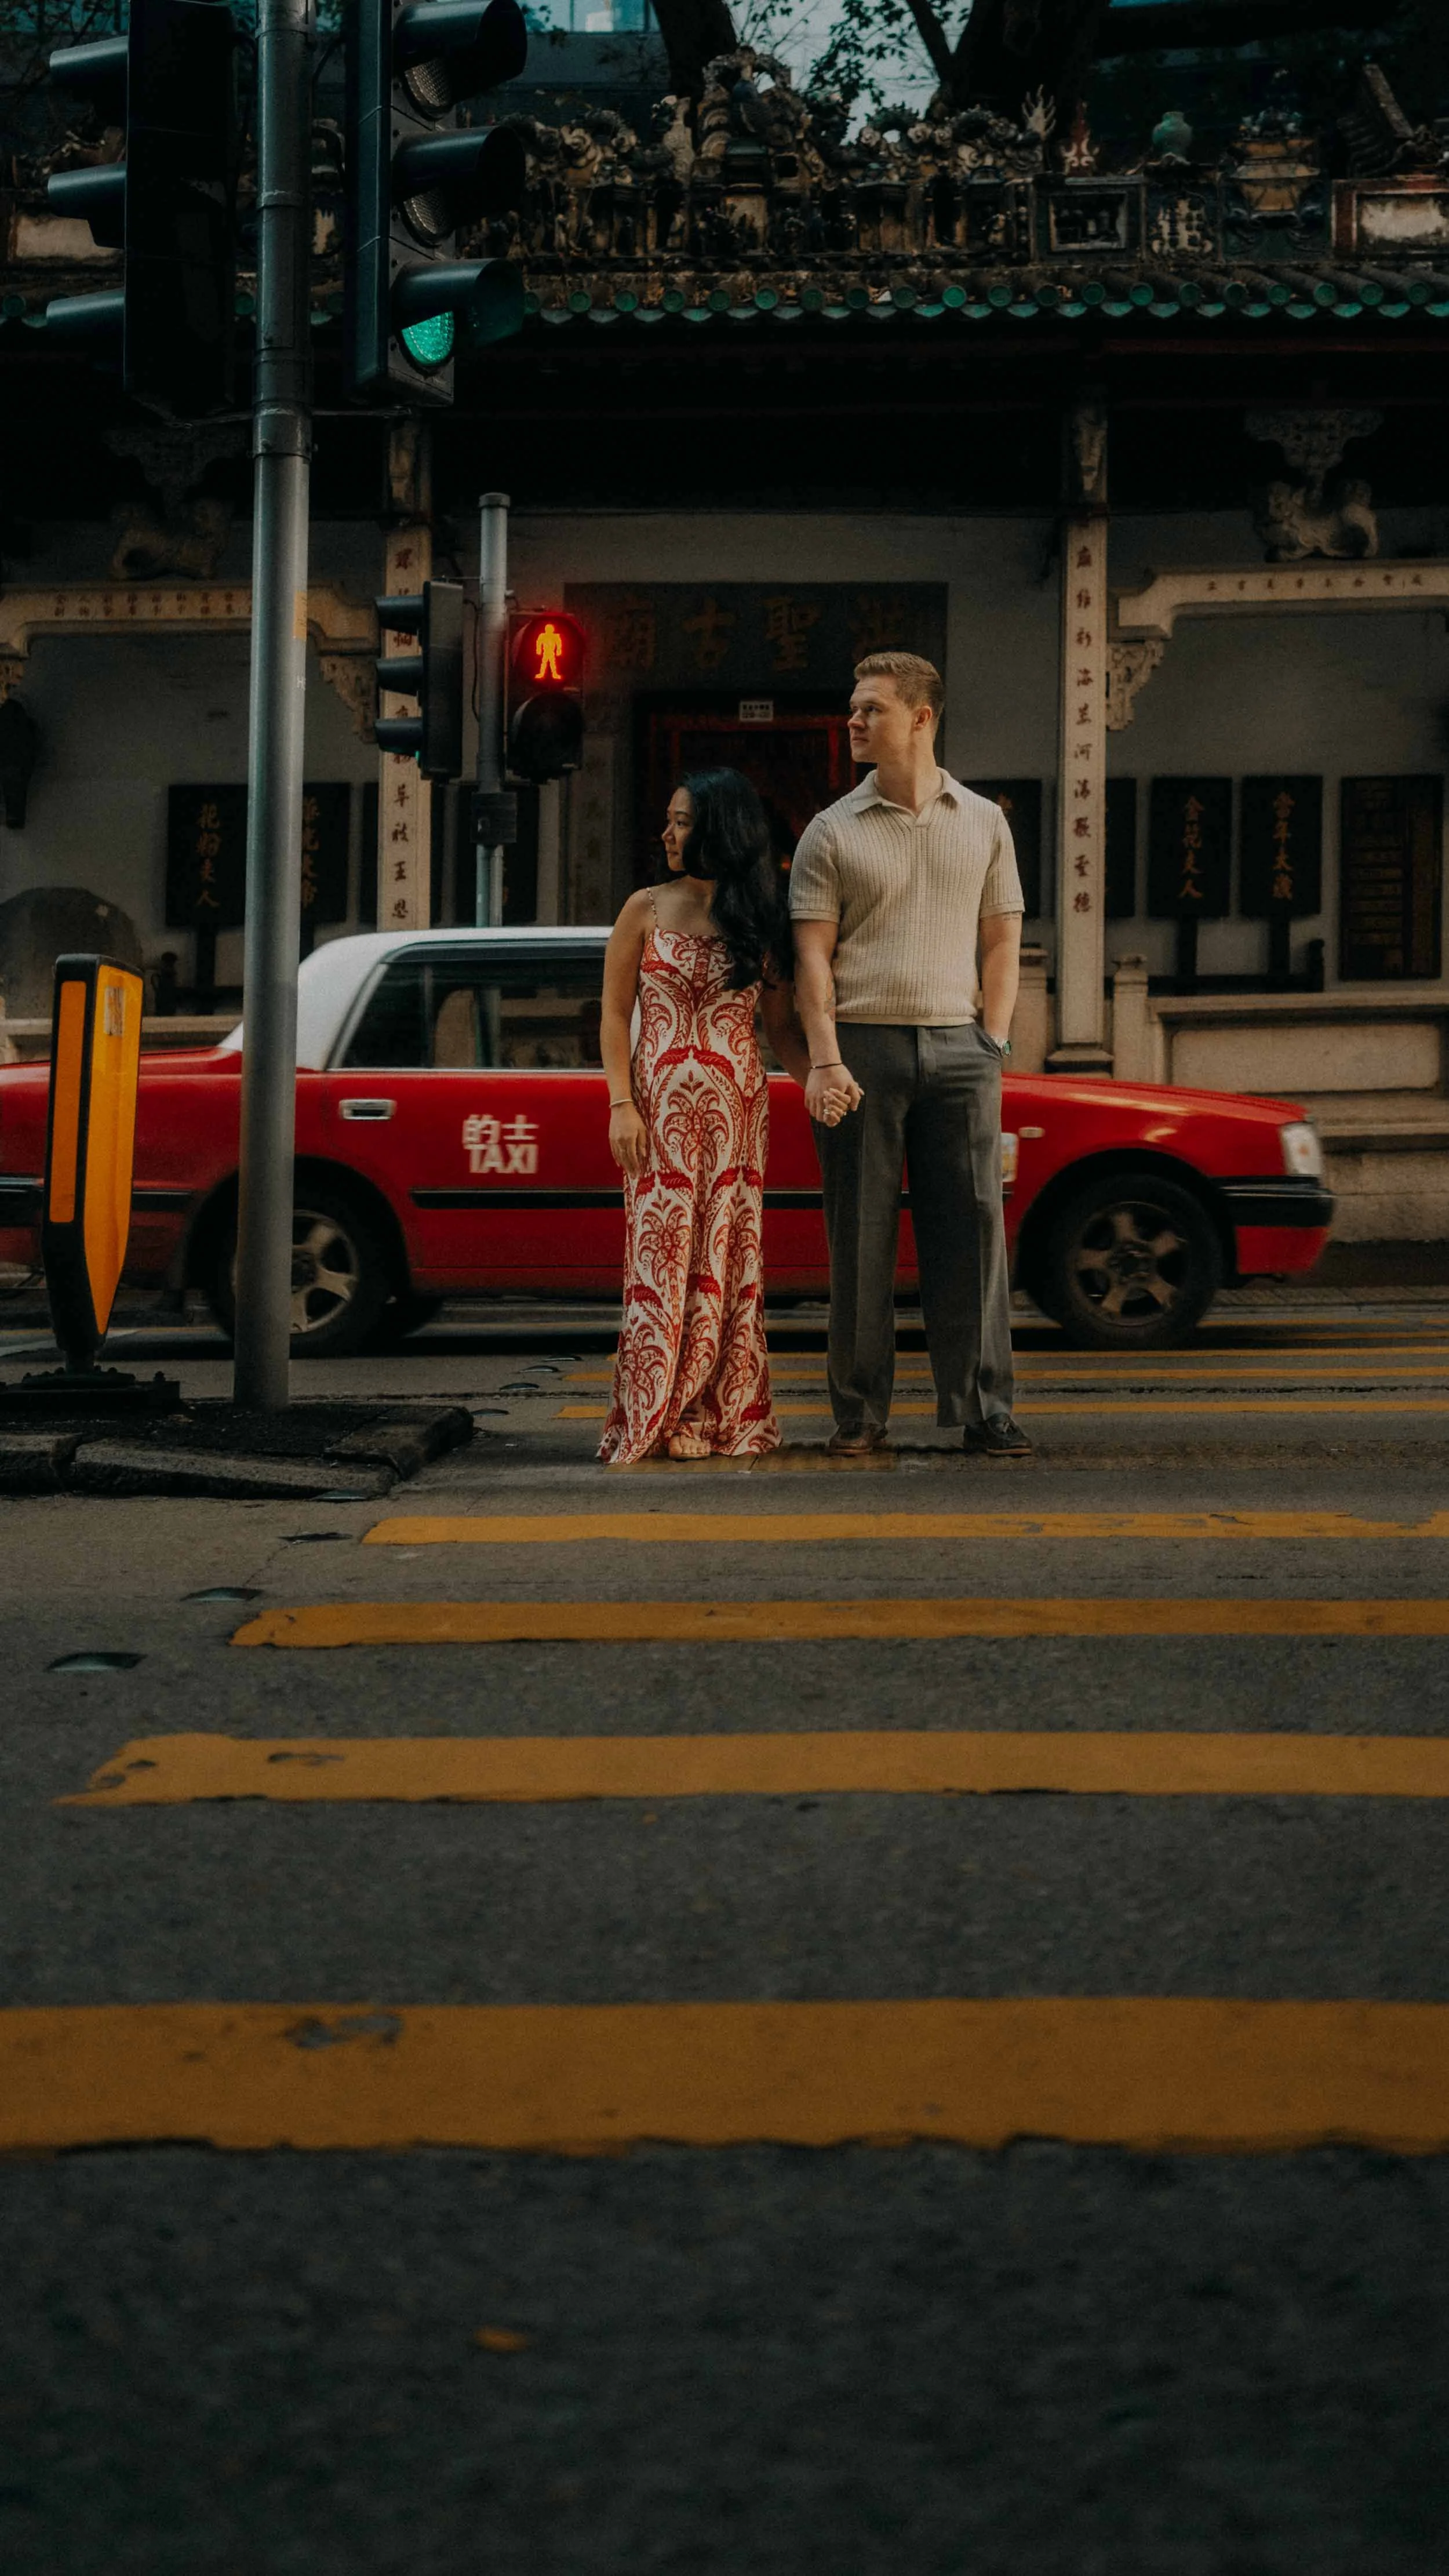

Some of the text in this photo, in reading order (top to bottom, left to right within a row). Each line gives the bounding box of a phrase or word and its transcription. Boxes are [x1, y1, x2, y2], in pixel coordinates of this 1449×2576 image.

[1177, 795, 1206, 900] 金花夫人
[462, 1114, 540, 1144] 的士
[464, 1143, 540, 1174] TAXI
